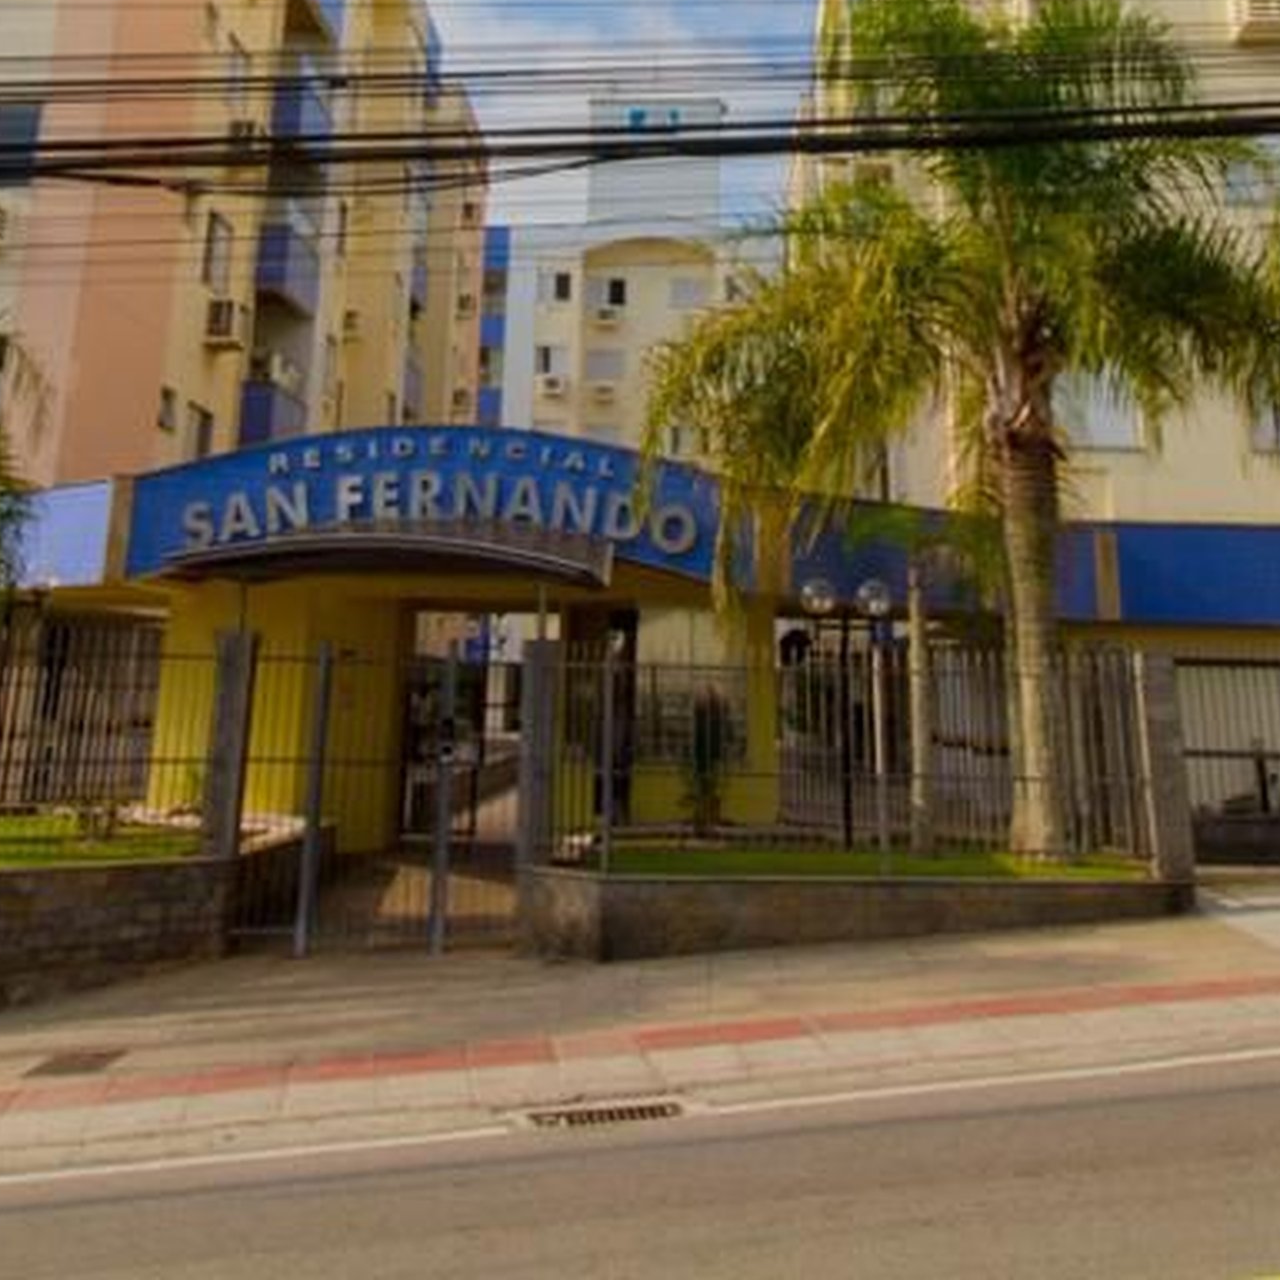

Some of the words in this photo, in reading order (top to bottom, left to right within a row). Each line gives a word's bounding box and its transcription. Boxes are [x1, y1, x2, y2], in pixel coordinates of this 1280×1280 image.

[269, 437, 615, 478] RESIDENCIAL
[182, 481, 309, 553] SAN
[337, 473, 697, 553] FERNANDO
